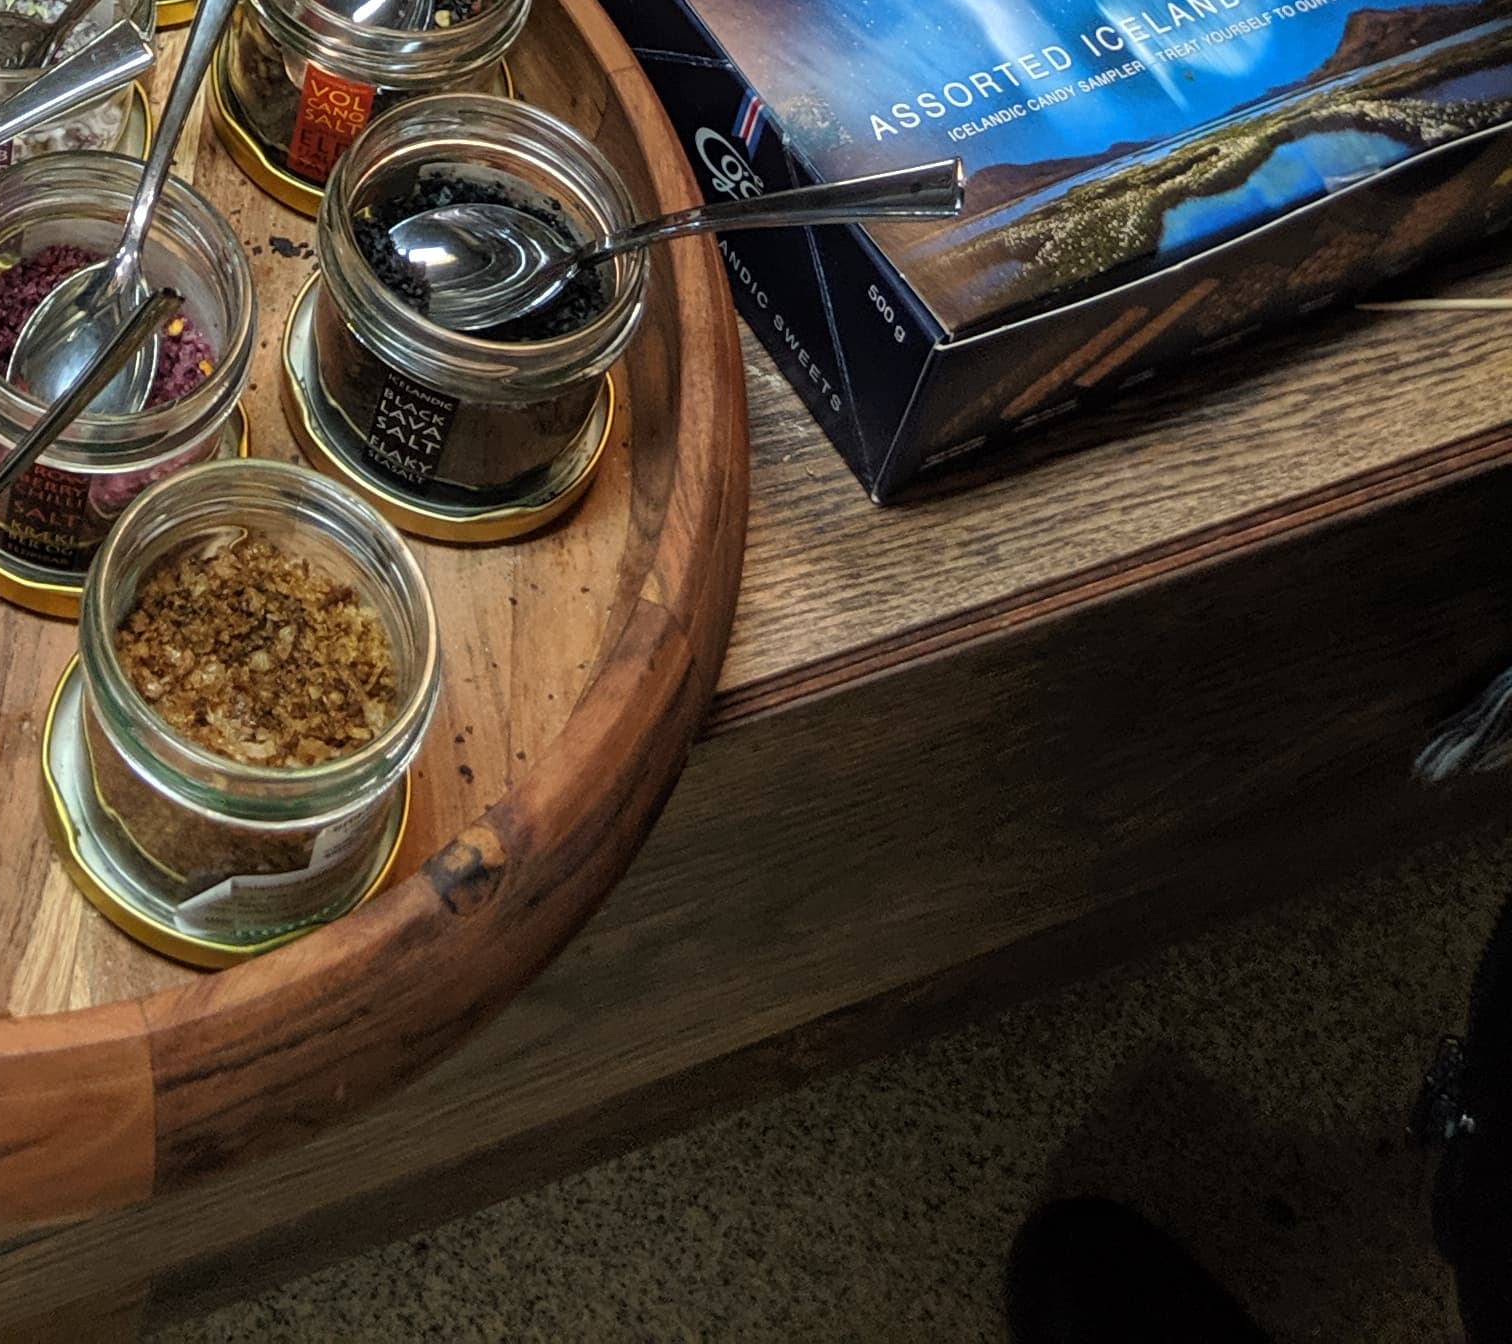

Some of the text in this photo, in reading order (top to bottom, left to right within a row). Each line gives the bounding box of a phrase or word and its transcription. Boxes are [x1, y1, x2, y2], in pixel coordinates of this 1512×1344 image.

[871, 45, 1073, 141] ASSORTED
[947, 105, 1027, 143] ICELANDIC
[1027, 84, 1077, 114] CANDY
[1080, 59, 1146, 94] SAMPLER
[1157, 39, 1201, 64] TREAT
[1202, 15, 1274, 55] YOURSELF
[1274, 5, 1296, 22] TO
[308, 98, 364, 122] CANO
[311, 80, 365, 112] VOL
[305, 109, 363, 135] SALT
[719, 240, 842, 412] ANDIC SWEETS
[867, 285, 906, 343] 500 g
[384, 388, 445, 426] BLACK
[388, 373, 452, 411] ICELANDIC
[376, 416, 440, 454] SALT
[380, 400, 441, 440] LAVA
[370, 435, 432, 473] FLAKY
